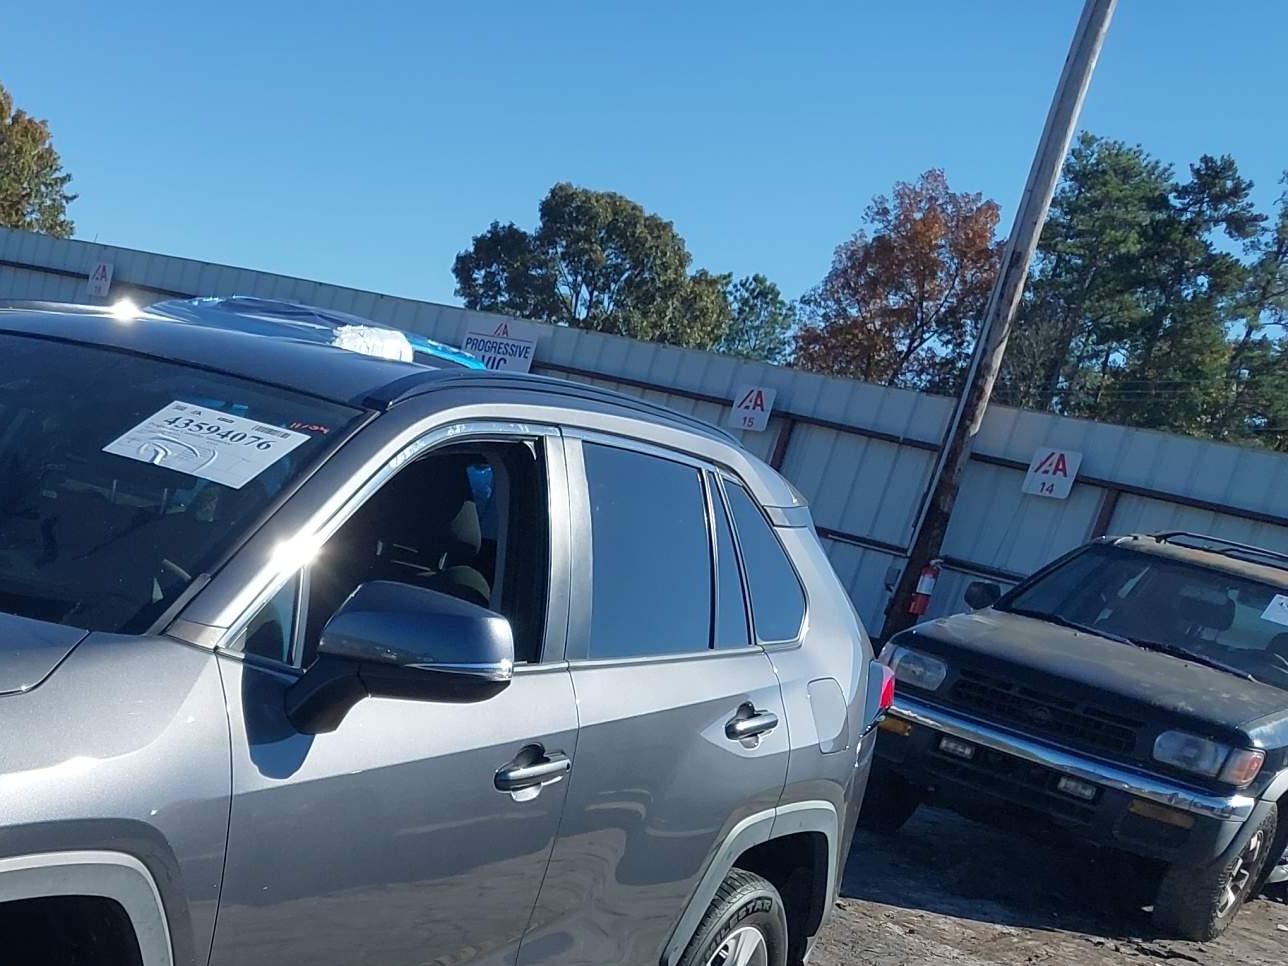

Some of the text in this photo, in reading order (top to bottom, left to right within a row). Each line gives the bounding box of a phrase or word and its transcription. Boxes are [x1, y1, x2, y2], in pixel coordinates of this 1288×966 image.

[464, 337, 531, 359] PROGRESSIVE
[742, 416, 755, 428] 15
[163, 416, 274, 451] 43594076
[1039, 481, 1055, 495] 14
